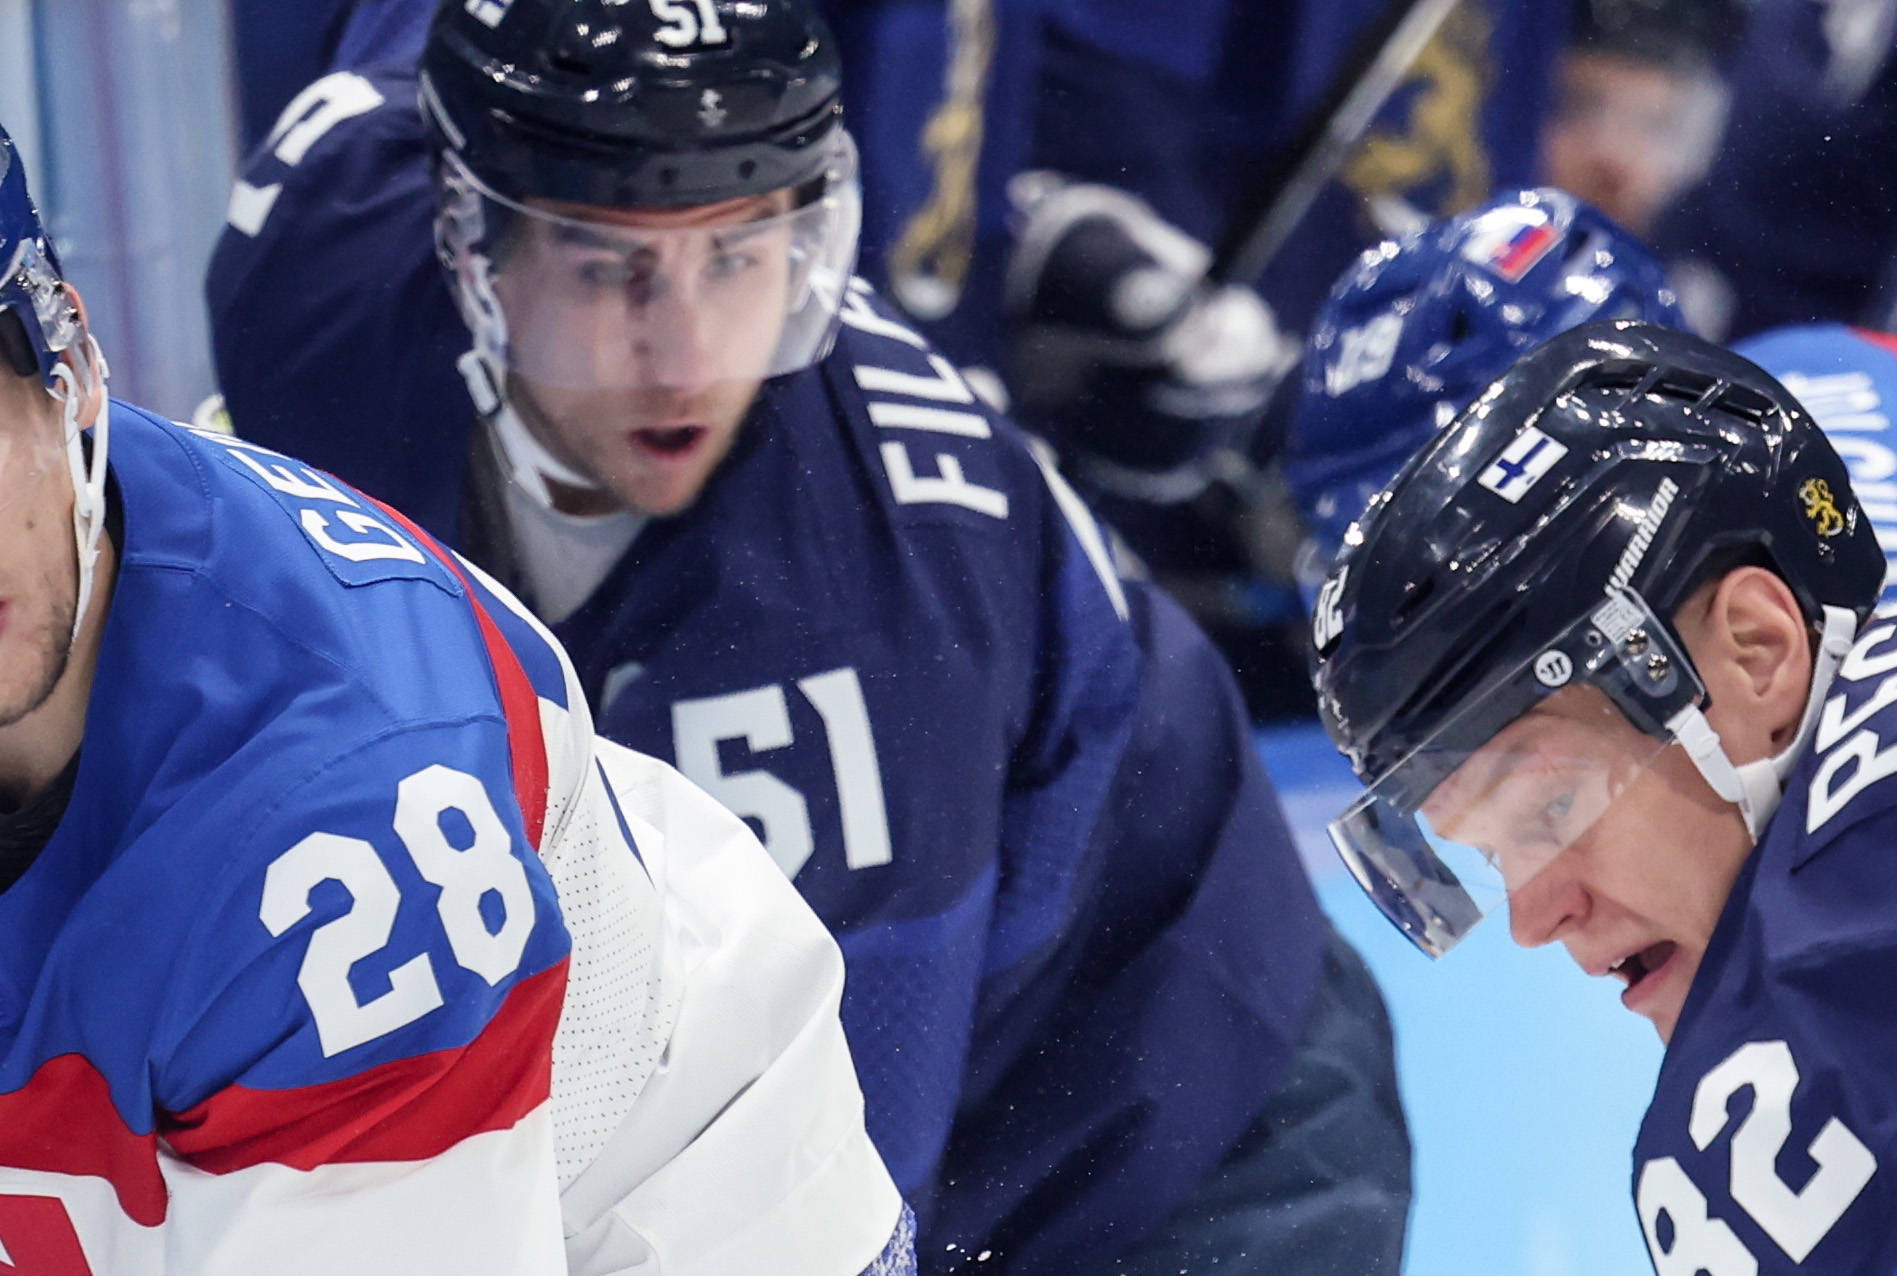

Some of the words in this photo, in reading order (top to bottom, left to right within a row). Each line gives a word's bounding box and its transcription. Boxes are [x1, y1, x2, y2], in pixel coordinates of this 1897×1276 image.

[649, 0, 729, 48] 51
[187, 426, 427, 565] GE
[672, 666, 893, 892] 51
[258, 763, 537, 1059] 28
